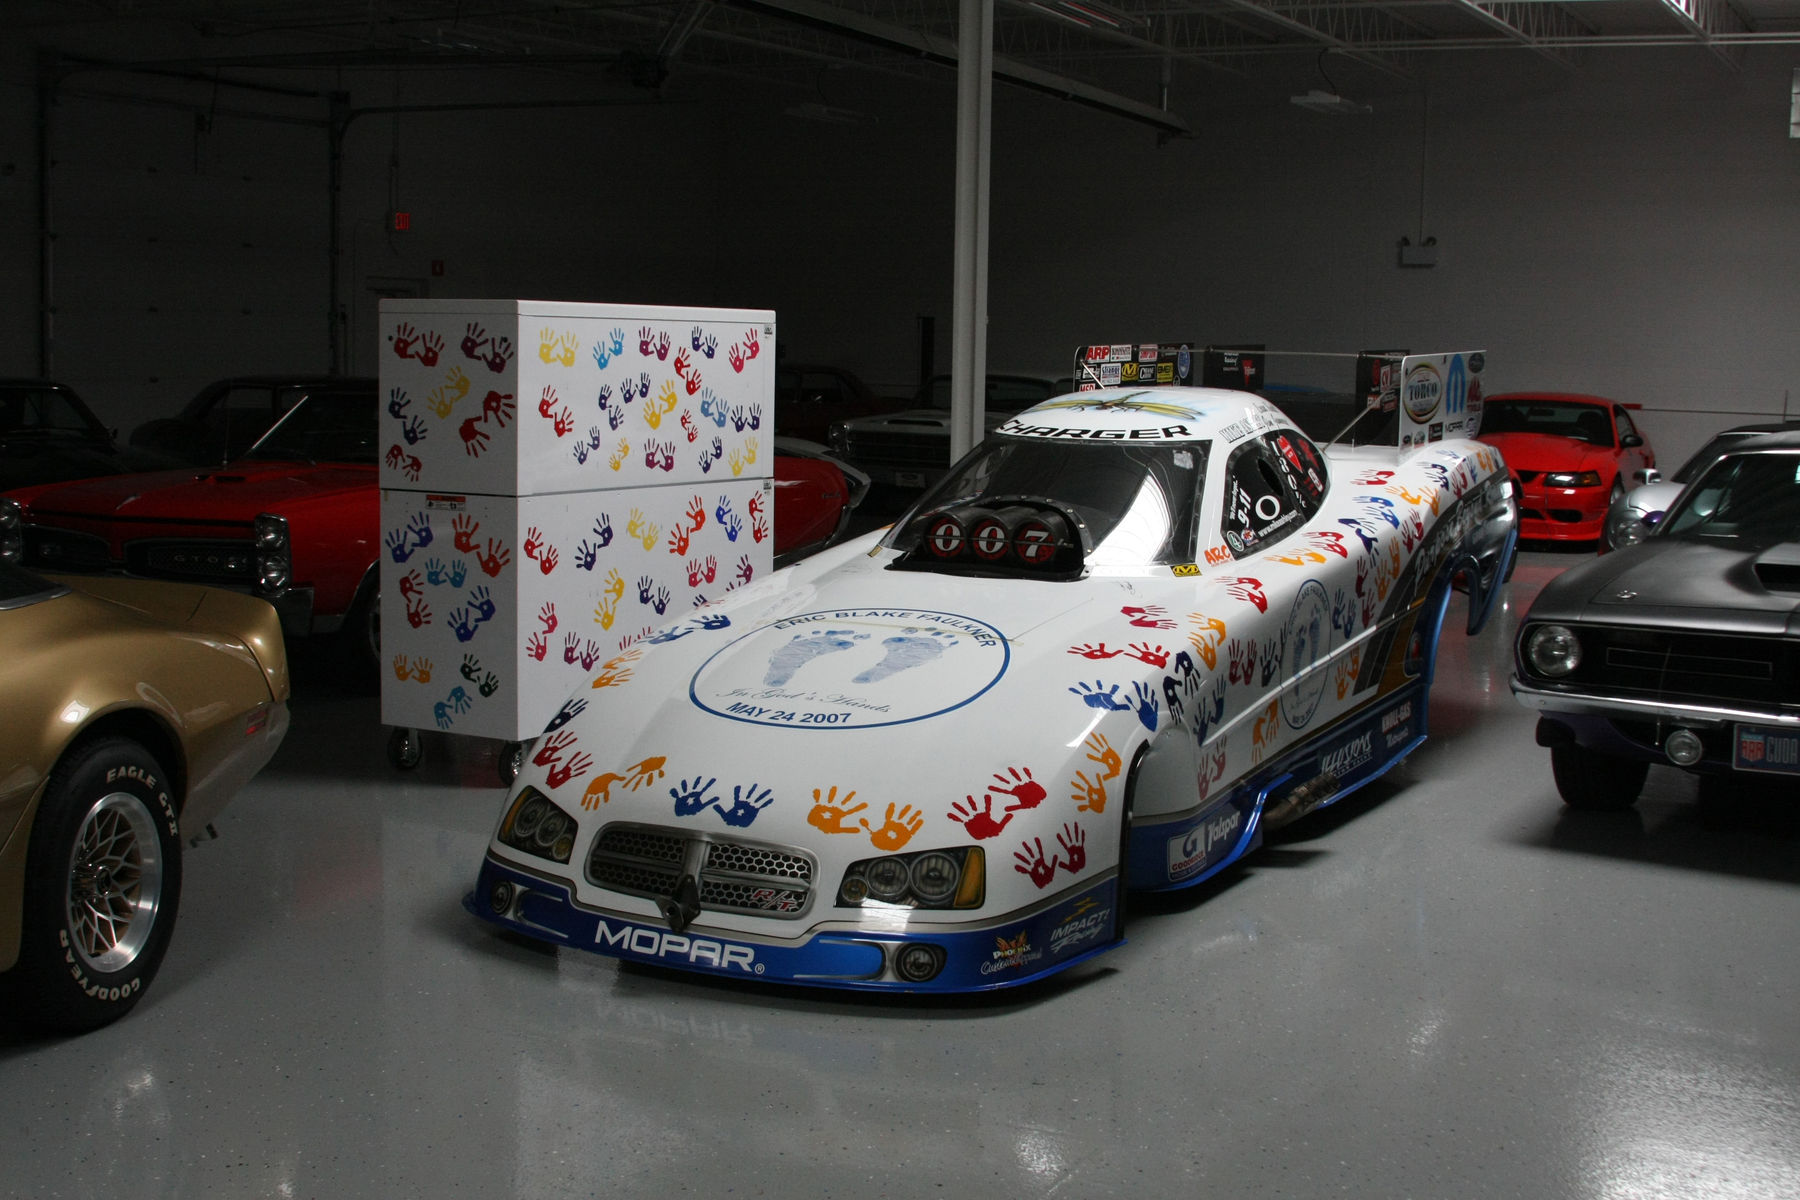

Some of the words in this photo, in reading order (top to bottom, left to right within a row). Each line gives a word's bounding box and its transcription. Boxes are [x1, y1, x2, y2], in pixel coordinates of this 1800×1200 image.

[1086, 346, 1110, 360] ARP
[1408, 382, 1437, 401] TORCO
[1000, 419, 1192, 439] CHARGER
[1204, 545, 1230, 564] ARC
[774, 614, 826, 630] ERIC
[835, 611, 913, 619] BLAKE
[917, 613, 997, 647] FAULKNER
[725, 702, 771, 717] MAY
[768, 710, 796, 721] 24
[800, 712, 852, 723] 2007
[820, 693, 892, 713] Hands
[106, 765, 157, 789] EAGLE
[752, 889, 797, 911] R/T
[59, 928, 140, 1001] GOODYEAR
